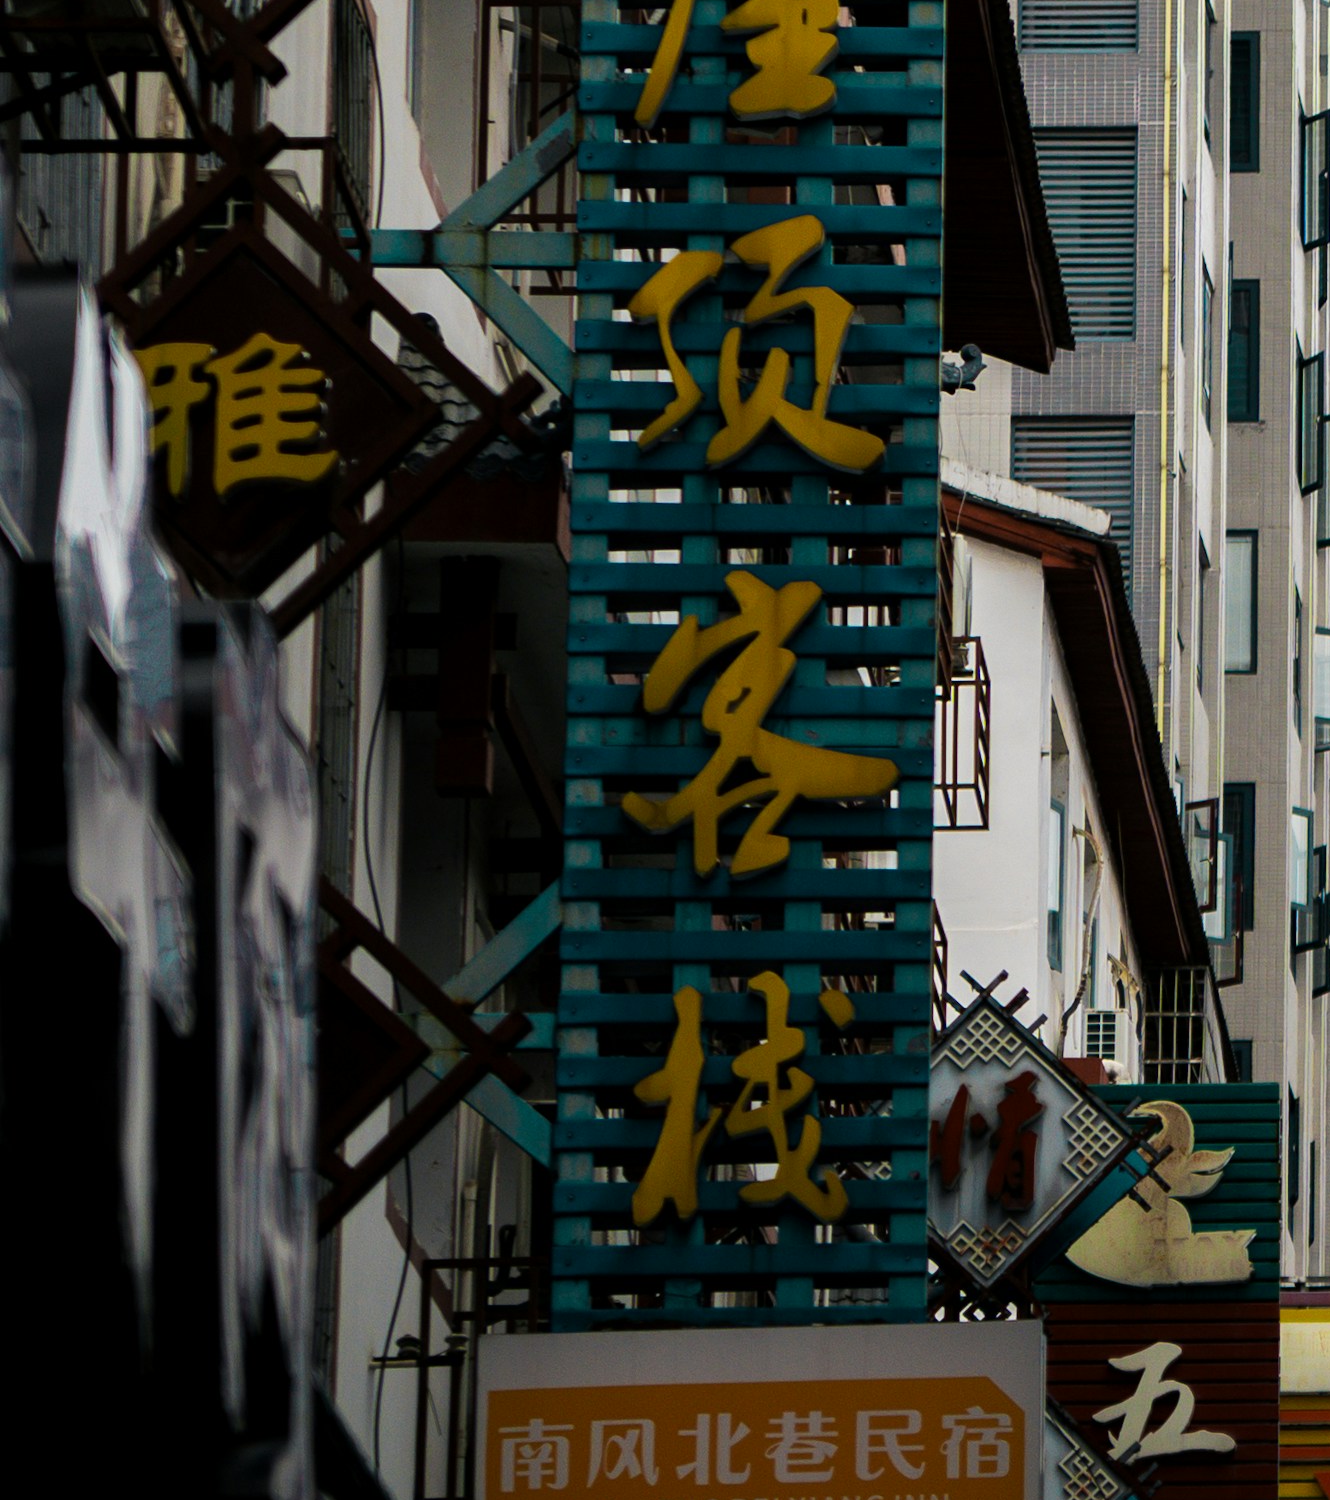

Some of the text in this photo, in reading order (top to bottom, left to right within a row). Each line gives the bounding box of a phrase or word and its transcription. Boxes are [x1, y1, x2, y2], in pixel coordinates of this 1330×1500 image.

[132, 332, 340, 498] 雅
[497, 1406, 1014, 1492] 南风北巷民宿
